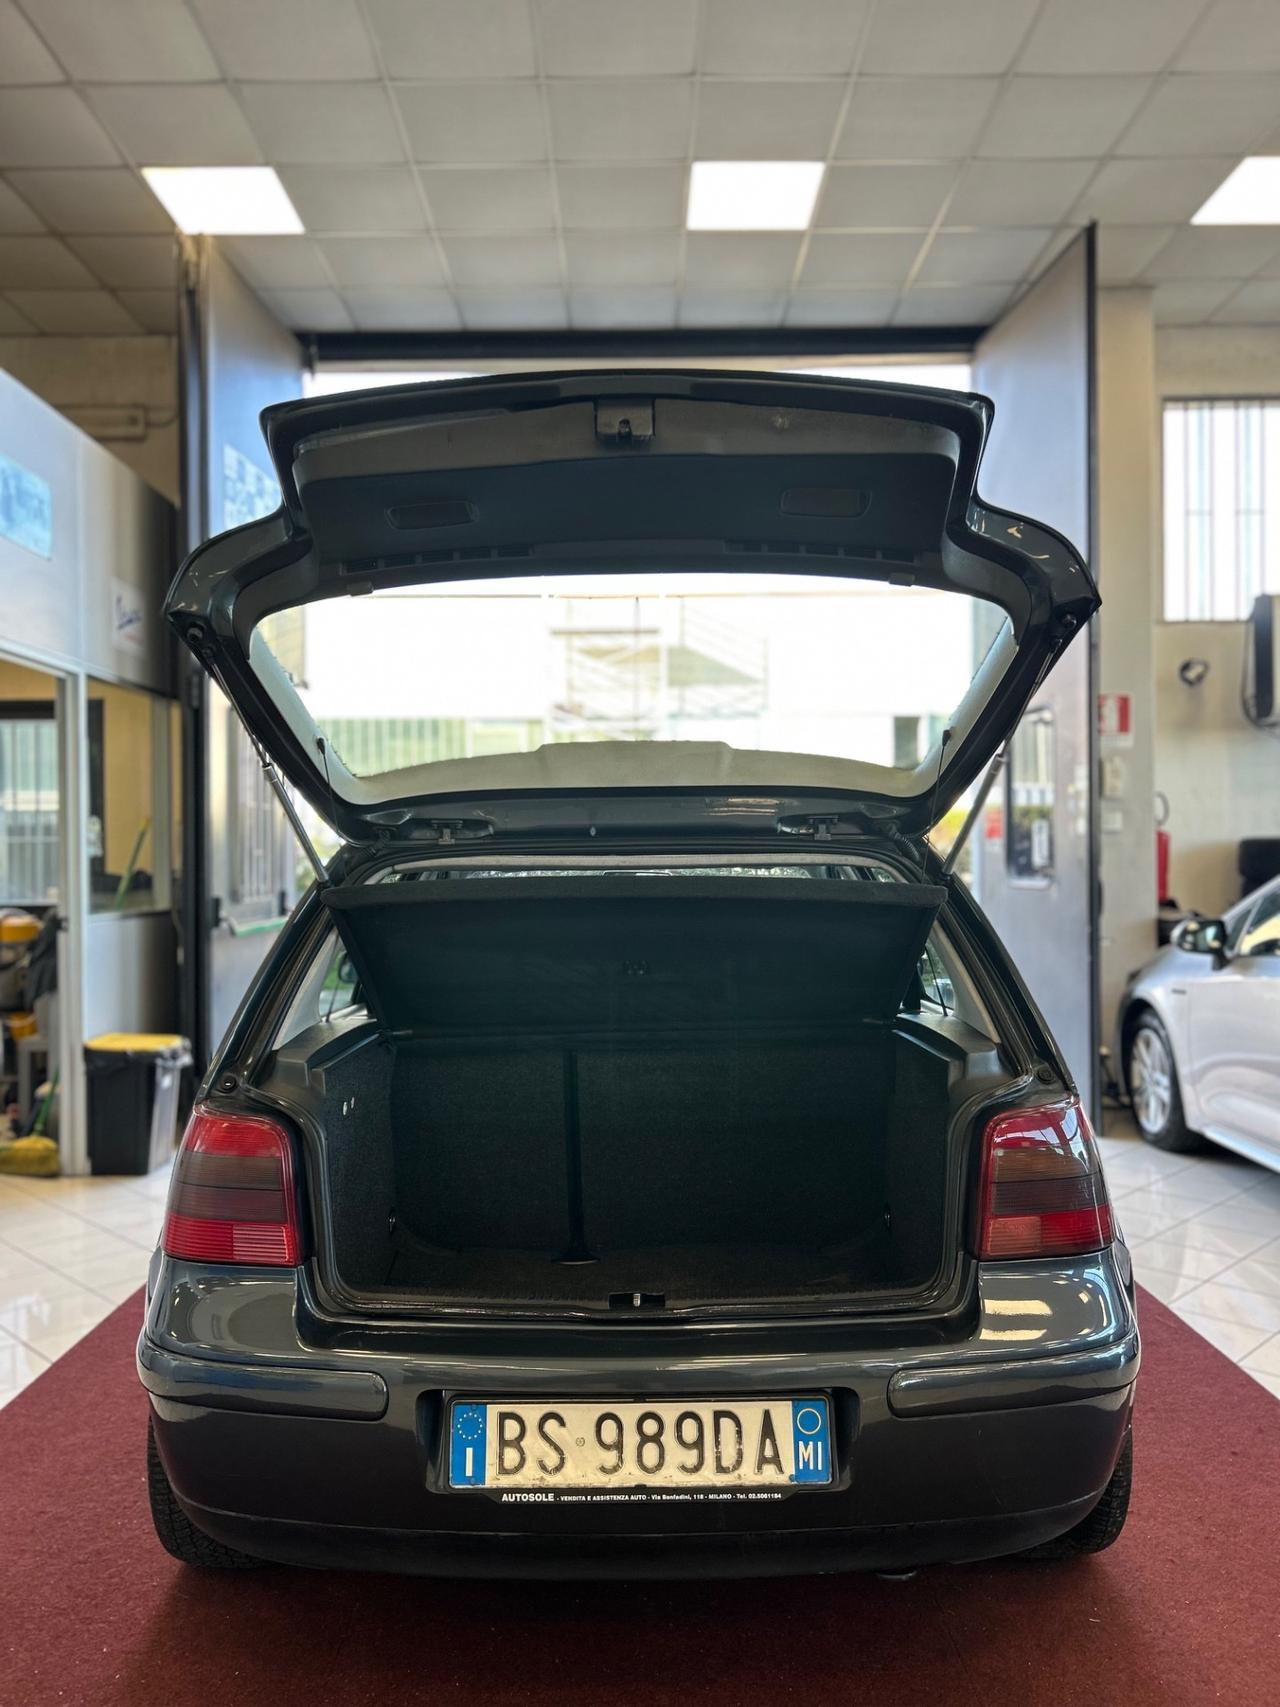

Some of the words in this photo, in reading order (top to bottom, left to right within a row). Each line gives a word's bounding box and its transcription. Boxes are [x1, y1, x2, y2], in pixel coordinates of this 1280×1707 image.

[497, 1411, 566, 1475] BS
[594, 1409, 784, 1475] 989DA
[798, 1440, 823, 1471] MI
[465, 1447, 473, 1477] I
[501, 1493, 554, 1502] AUTOSOLE
